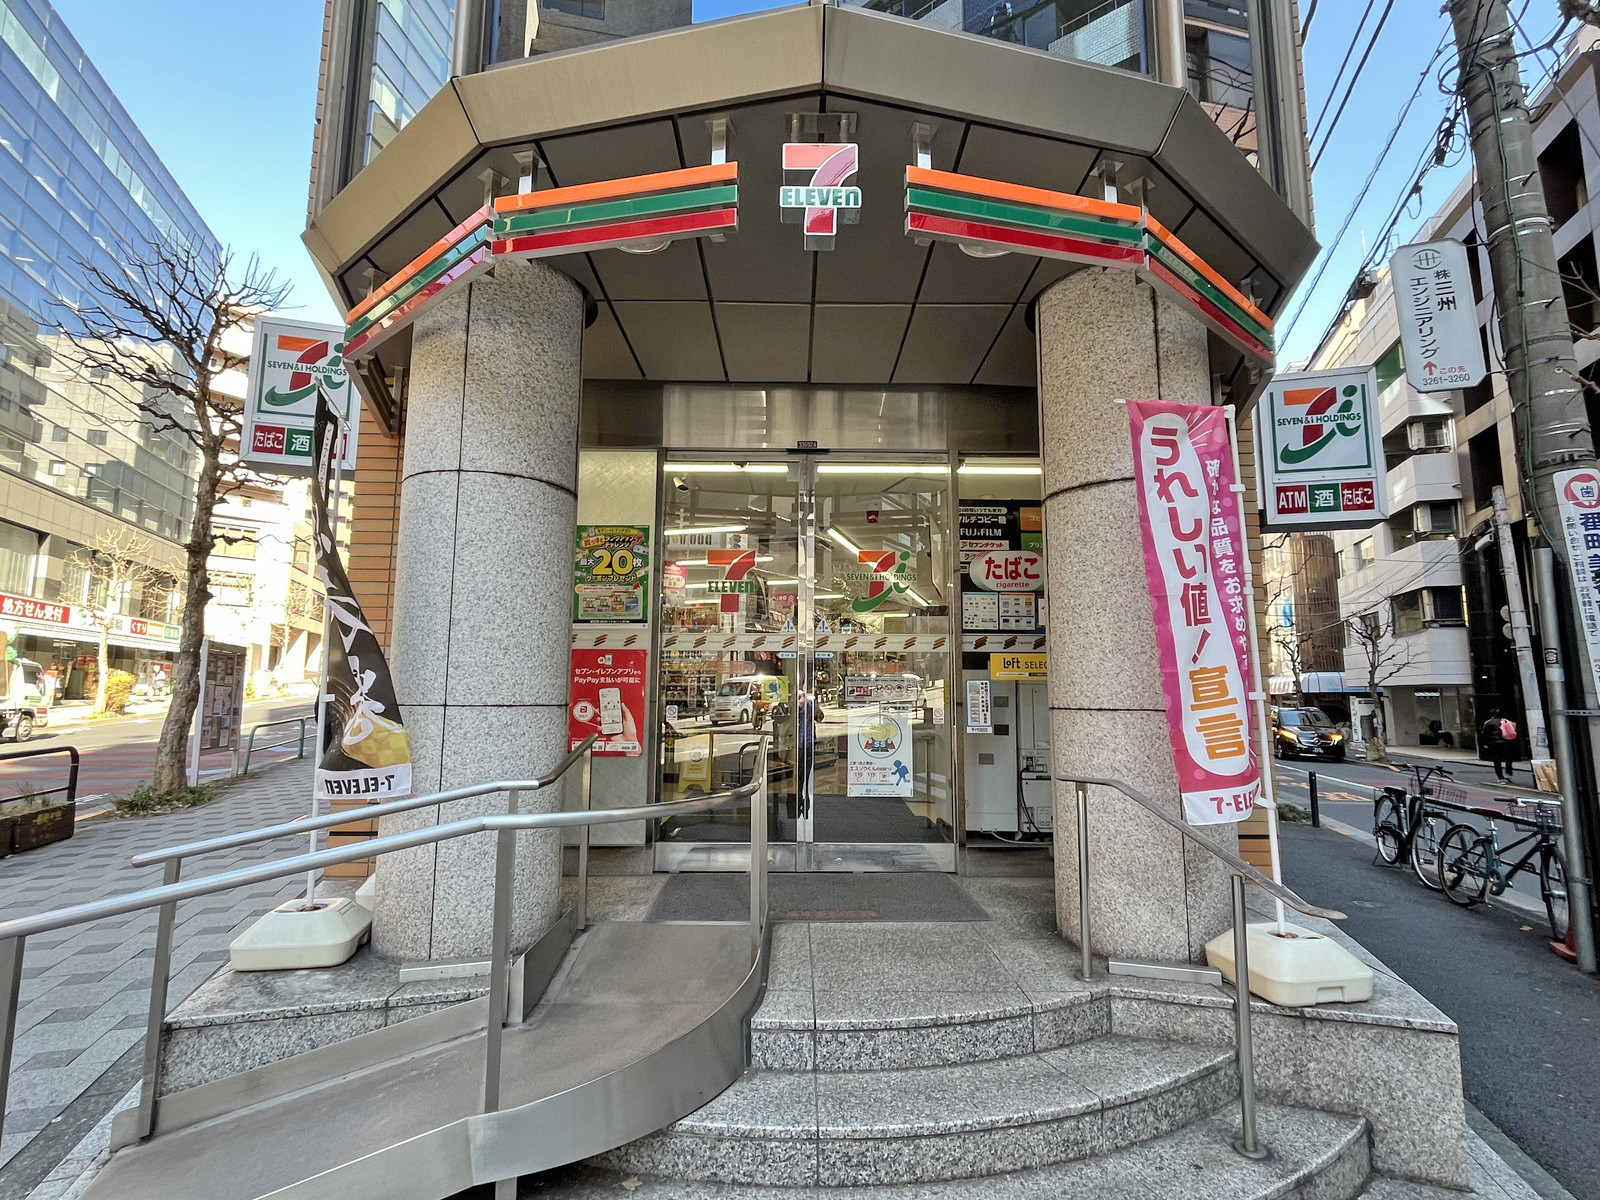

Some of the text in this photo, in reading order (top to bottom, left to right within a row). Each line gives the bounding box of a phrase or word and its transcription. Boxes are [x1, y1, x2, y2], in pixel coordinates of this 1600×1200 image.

[1410, 276, 1440, 359] エンジニアリング
[305, 365, 347, 376] HOLDINGS
[1440, 366, 1467, 375] この先
[1423, 373, 1471, 386] 3261-3260
[1316, 412, 1362, 423] HOLDINGS
[254, 430, 284, 449] たばこ
[291, 434, 311, 451] 酒
[1279, 491, 1306, 509] ATM
[1314, 489, 1334, 508] 酒
[1342, 487, 1374, 506] たばこ
[985, 556, 1041, 580] たばこ
[880, 573, 917, 581] HODINGS
[996, 581, 1030, 589] cigarette
[2, 597, 64, 623] 処方せん受付
[131, 621, 148, 634] くすり
